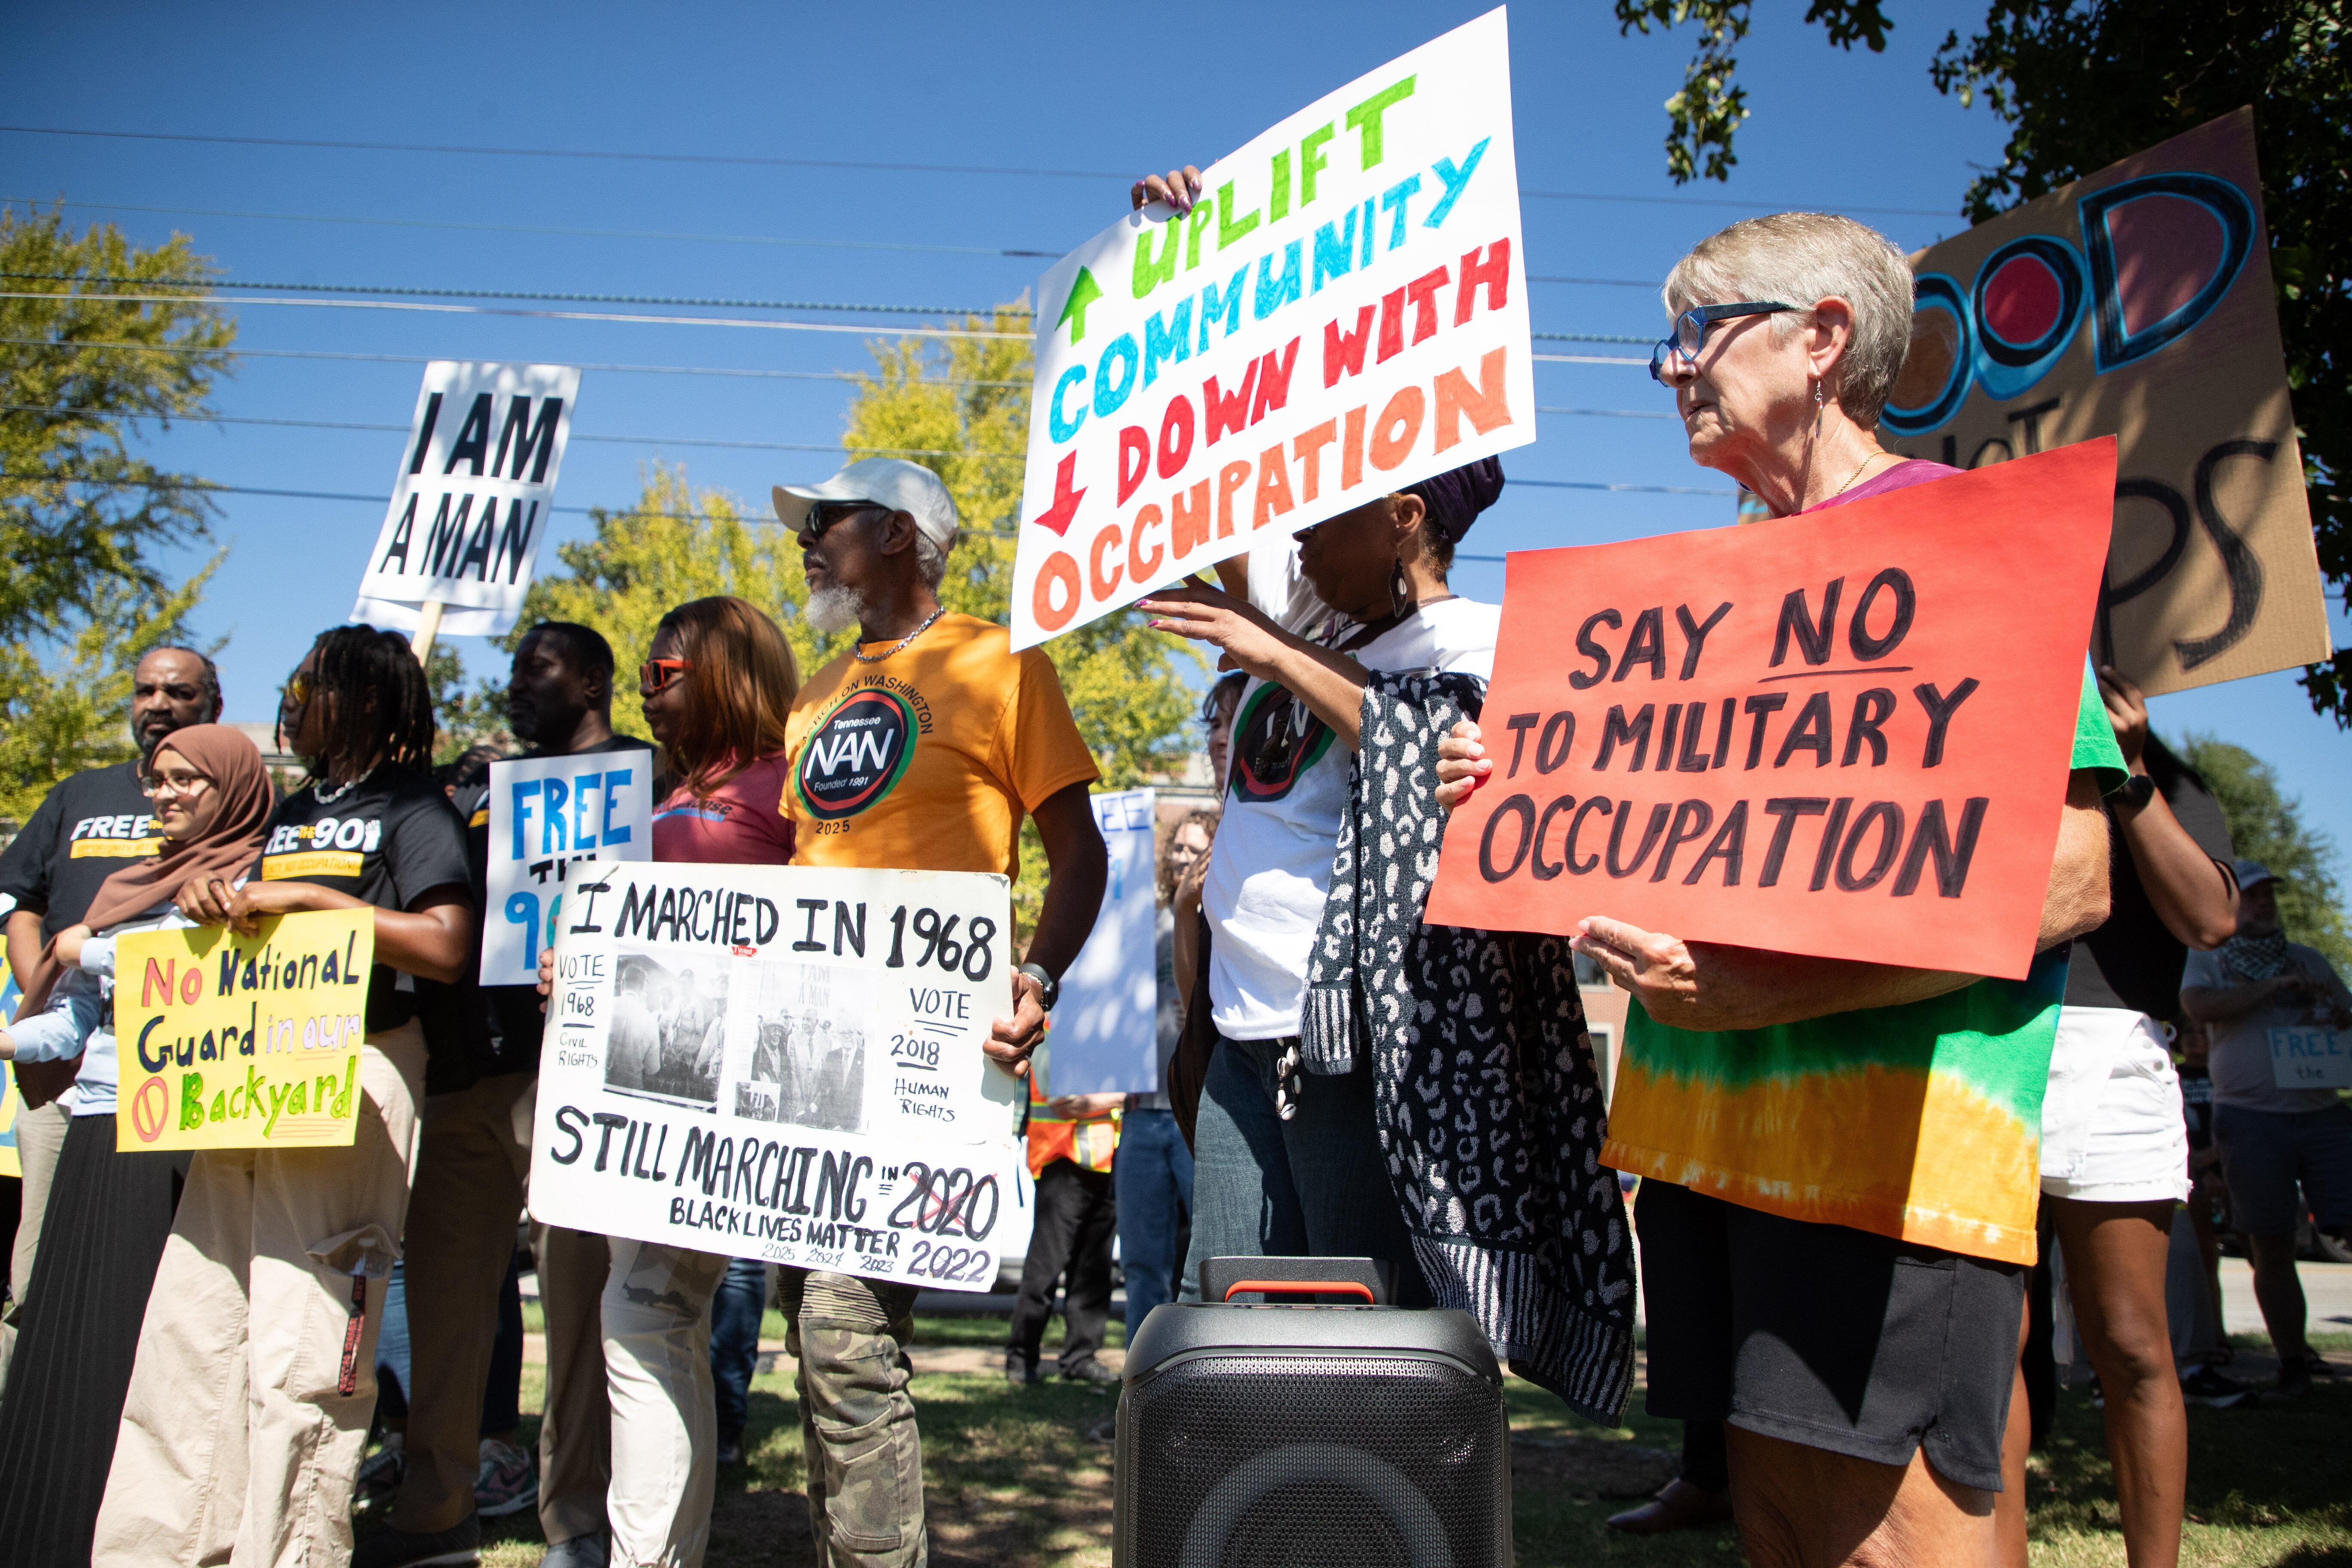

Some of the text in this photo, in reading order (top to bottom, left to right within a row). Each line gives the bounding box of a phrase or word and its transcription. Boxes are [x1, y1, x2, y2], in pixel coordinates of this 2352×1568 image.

[1132, 74, 1417, 300] UPLIFT
[1049, 136, 1491, 444] COMMUNITY
[1879, 171, 2256, 435] OOD
[1118, 236, 1510, 508] DOWN WITH
[408, 392, 564, 483] I AM
[1032, 346, 1513, 631] OCCUPATION
[378, 493, 539, 585] A MAN
[1568, 567, 1916, 689] SAY NO
[802, 674, 933, 747] MARCH ON WASHINGTON
[834, 717, 881, 730] Tennessee
[1506, 677, 1980, 778] TO MILITARY
[805, 729, 894, 779] NAN
[814, 776, 869, 791] Founded 1991
[70, 815, 154, 841] FREE
[299, 826, 316, 839] THE
[311, 818, 365, 849] 90
[512, 769, 632, 860] FREE
[816, 820, 850, 834] 2025
[1479, 793, 1989, 898] OCCUPATION
[570, 882, 997, 982] I MARCHED IN 1968
[141, 958, 202, 1008] No
[560, 955, 604, 978] VOTE
[808, 965, 831, 984] AM
[561, 992, 594, 1016] 1968
[798, 983, 830, 1008] A MAN
[910, 987, 971, 1019] VOTE
[138, 1001, 361, 1073] Guard in our
[559, 1050, 597, 1068] RIGHTS
[891, 1035, 940, 1065] 2018
[179, 1055, 356, 1141] Backyard
[894, 1078, 949, 1099] HUMAN
[899, 1099, 955, 1122] RIGHTS
[551, 1105, 999, 1242] STILL MARCHING IN 2020
[669, 1197, 900, 1259] BLACK LIVES MATTER
[761, 1243, 796, 1261] 2025
[907, 1240, 991, 1283] 2022
